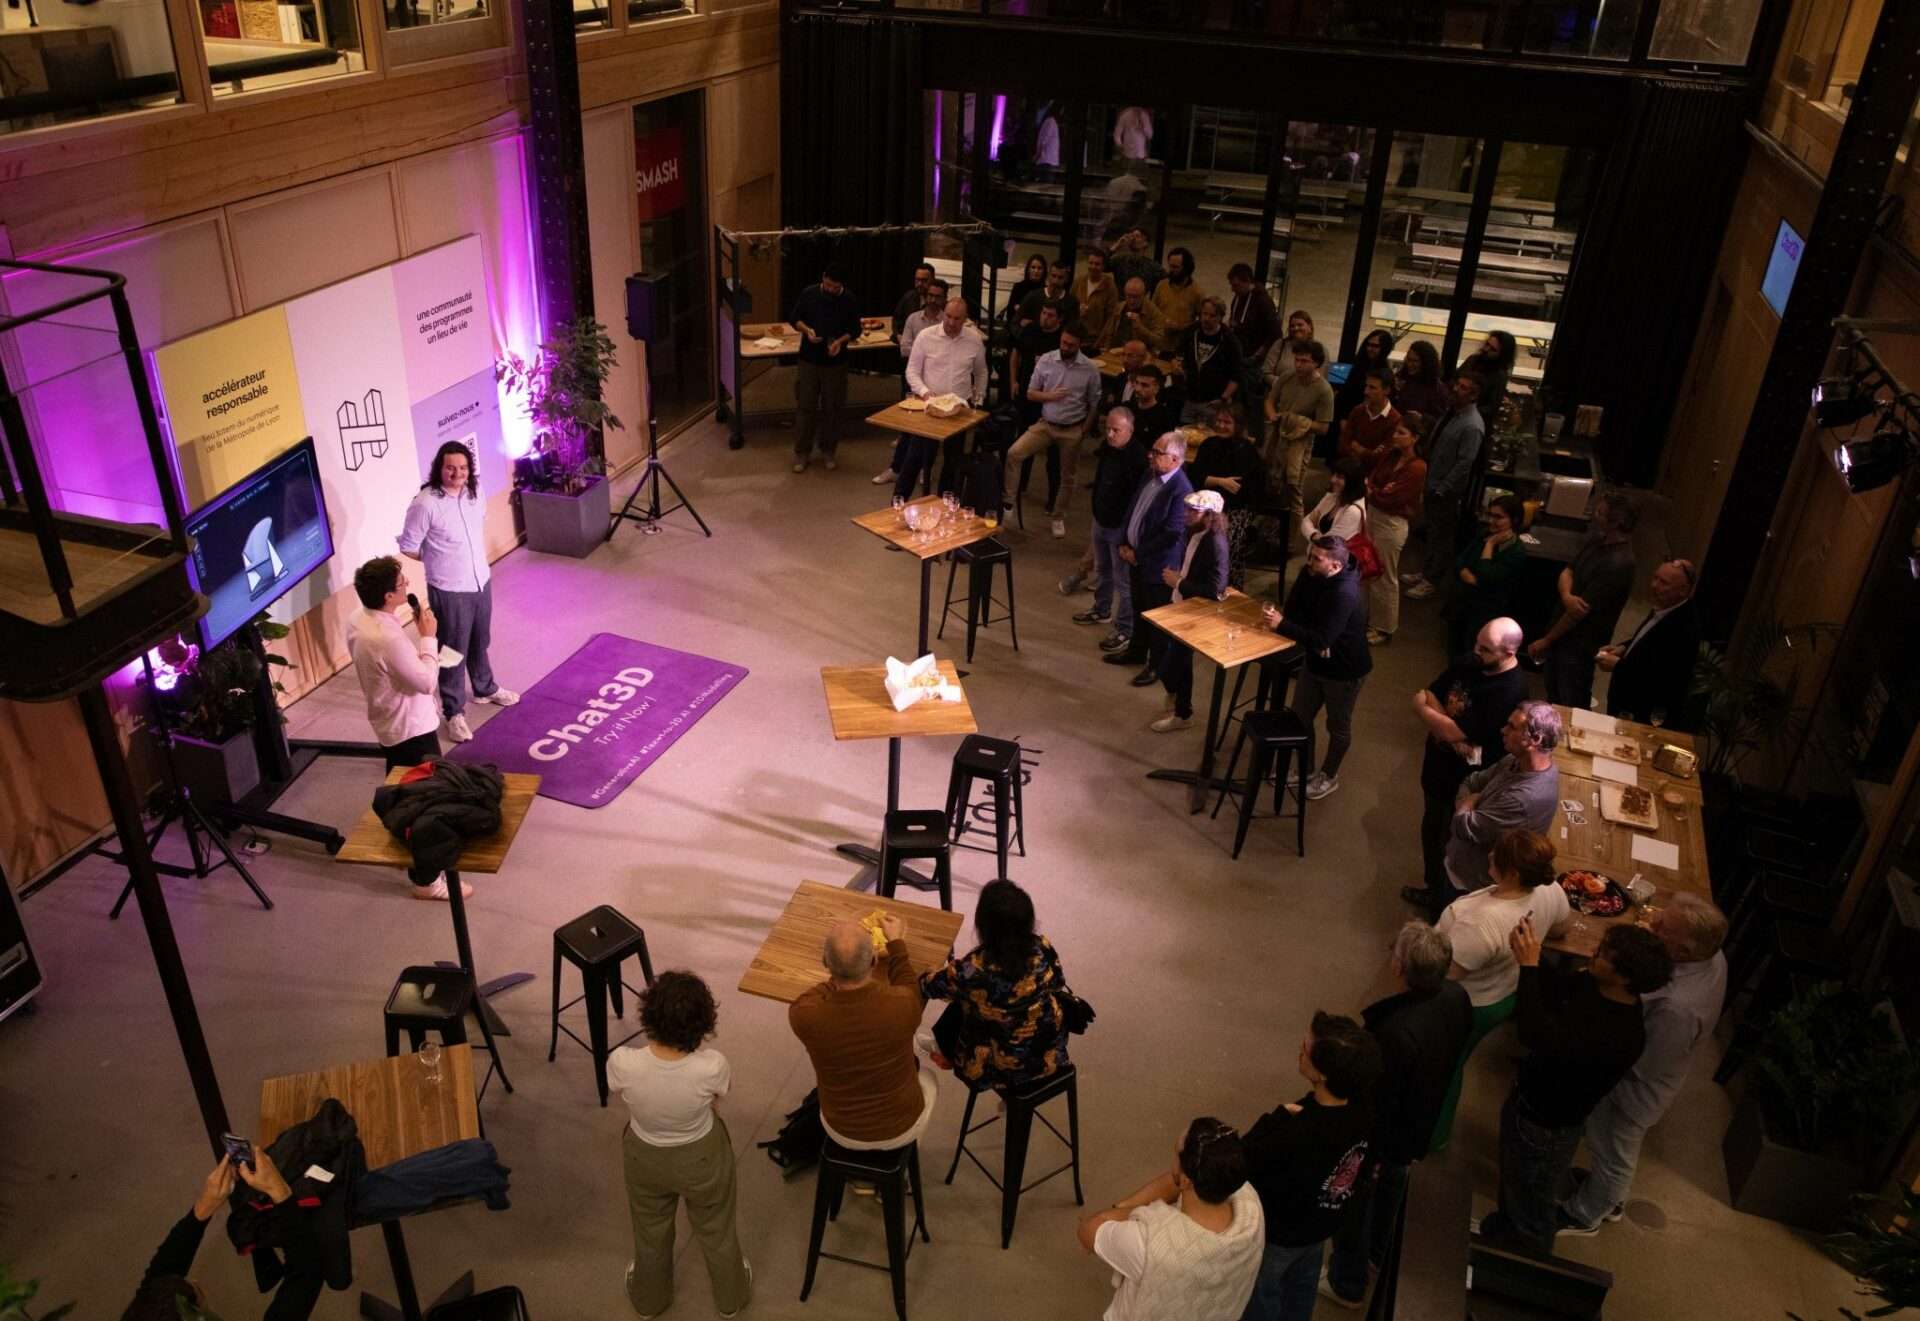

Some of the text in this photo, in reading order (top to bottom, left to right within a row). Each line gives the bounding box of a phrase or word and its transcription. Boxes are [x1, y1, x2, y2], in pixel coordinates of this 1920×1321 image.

[636, 157, 679, 193] SMASH
[416, 290, 473, 321] une communauté
[420, 305, 473, 334] des programmes
[427, 320, 468, 344] un lieu de vie
[202, 369, 266, 404] accélérateur
[206, 384, 269, 419] responsable
[528, 667, 654, 761] Chat3D
[593, 729, 620, 746] Try
[611, 719, 626, 731] it
[620, 702, 651, 724] Now
